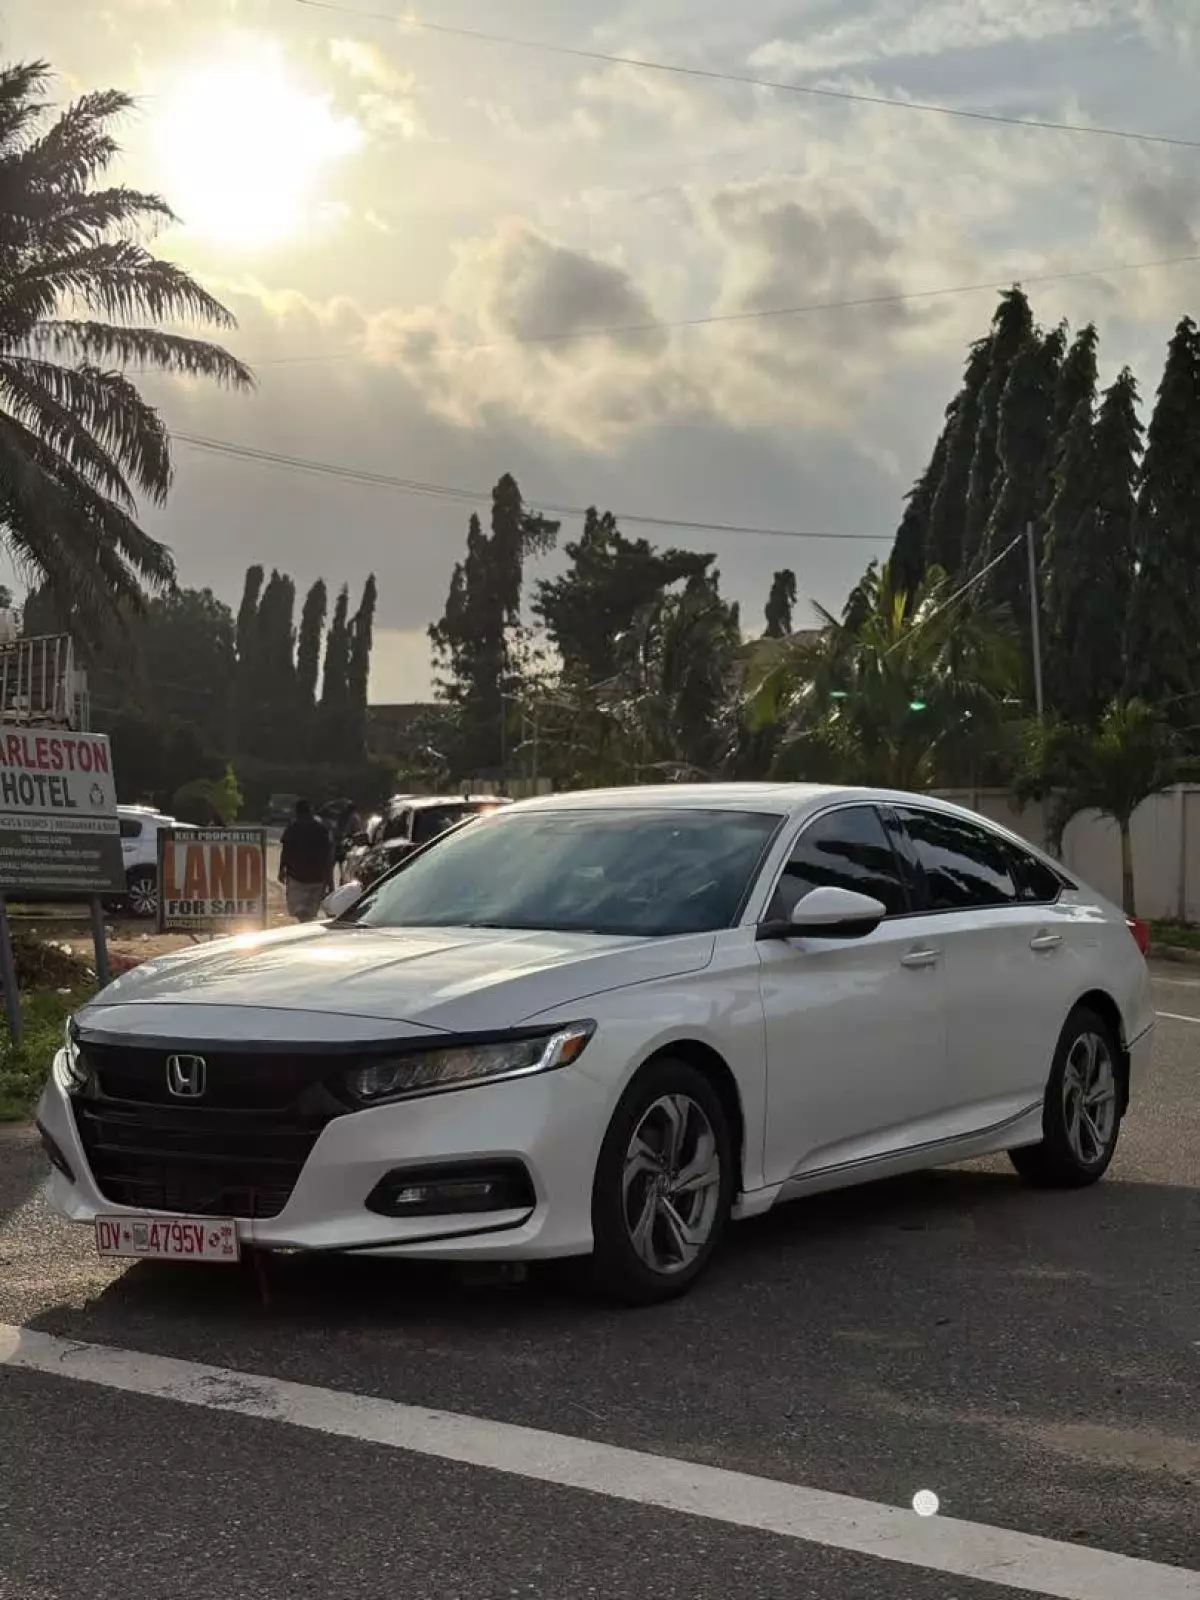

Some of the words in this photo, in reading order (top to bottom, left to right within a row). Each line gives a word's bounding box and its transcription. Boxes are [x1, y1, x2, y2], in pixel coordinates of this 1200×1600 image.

[1, 771, 78, 807] HOTEL
[164, 842, 261, 900] LAND
[168, 900, 205, 915] FOR
[211, 900, 258, 915] SALE
[99, 1221, 121, 1250] DV
[150, 1222, 204, 1253] 4795V
